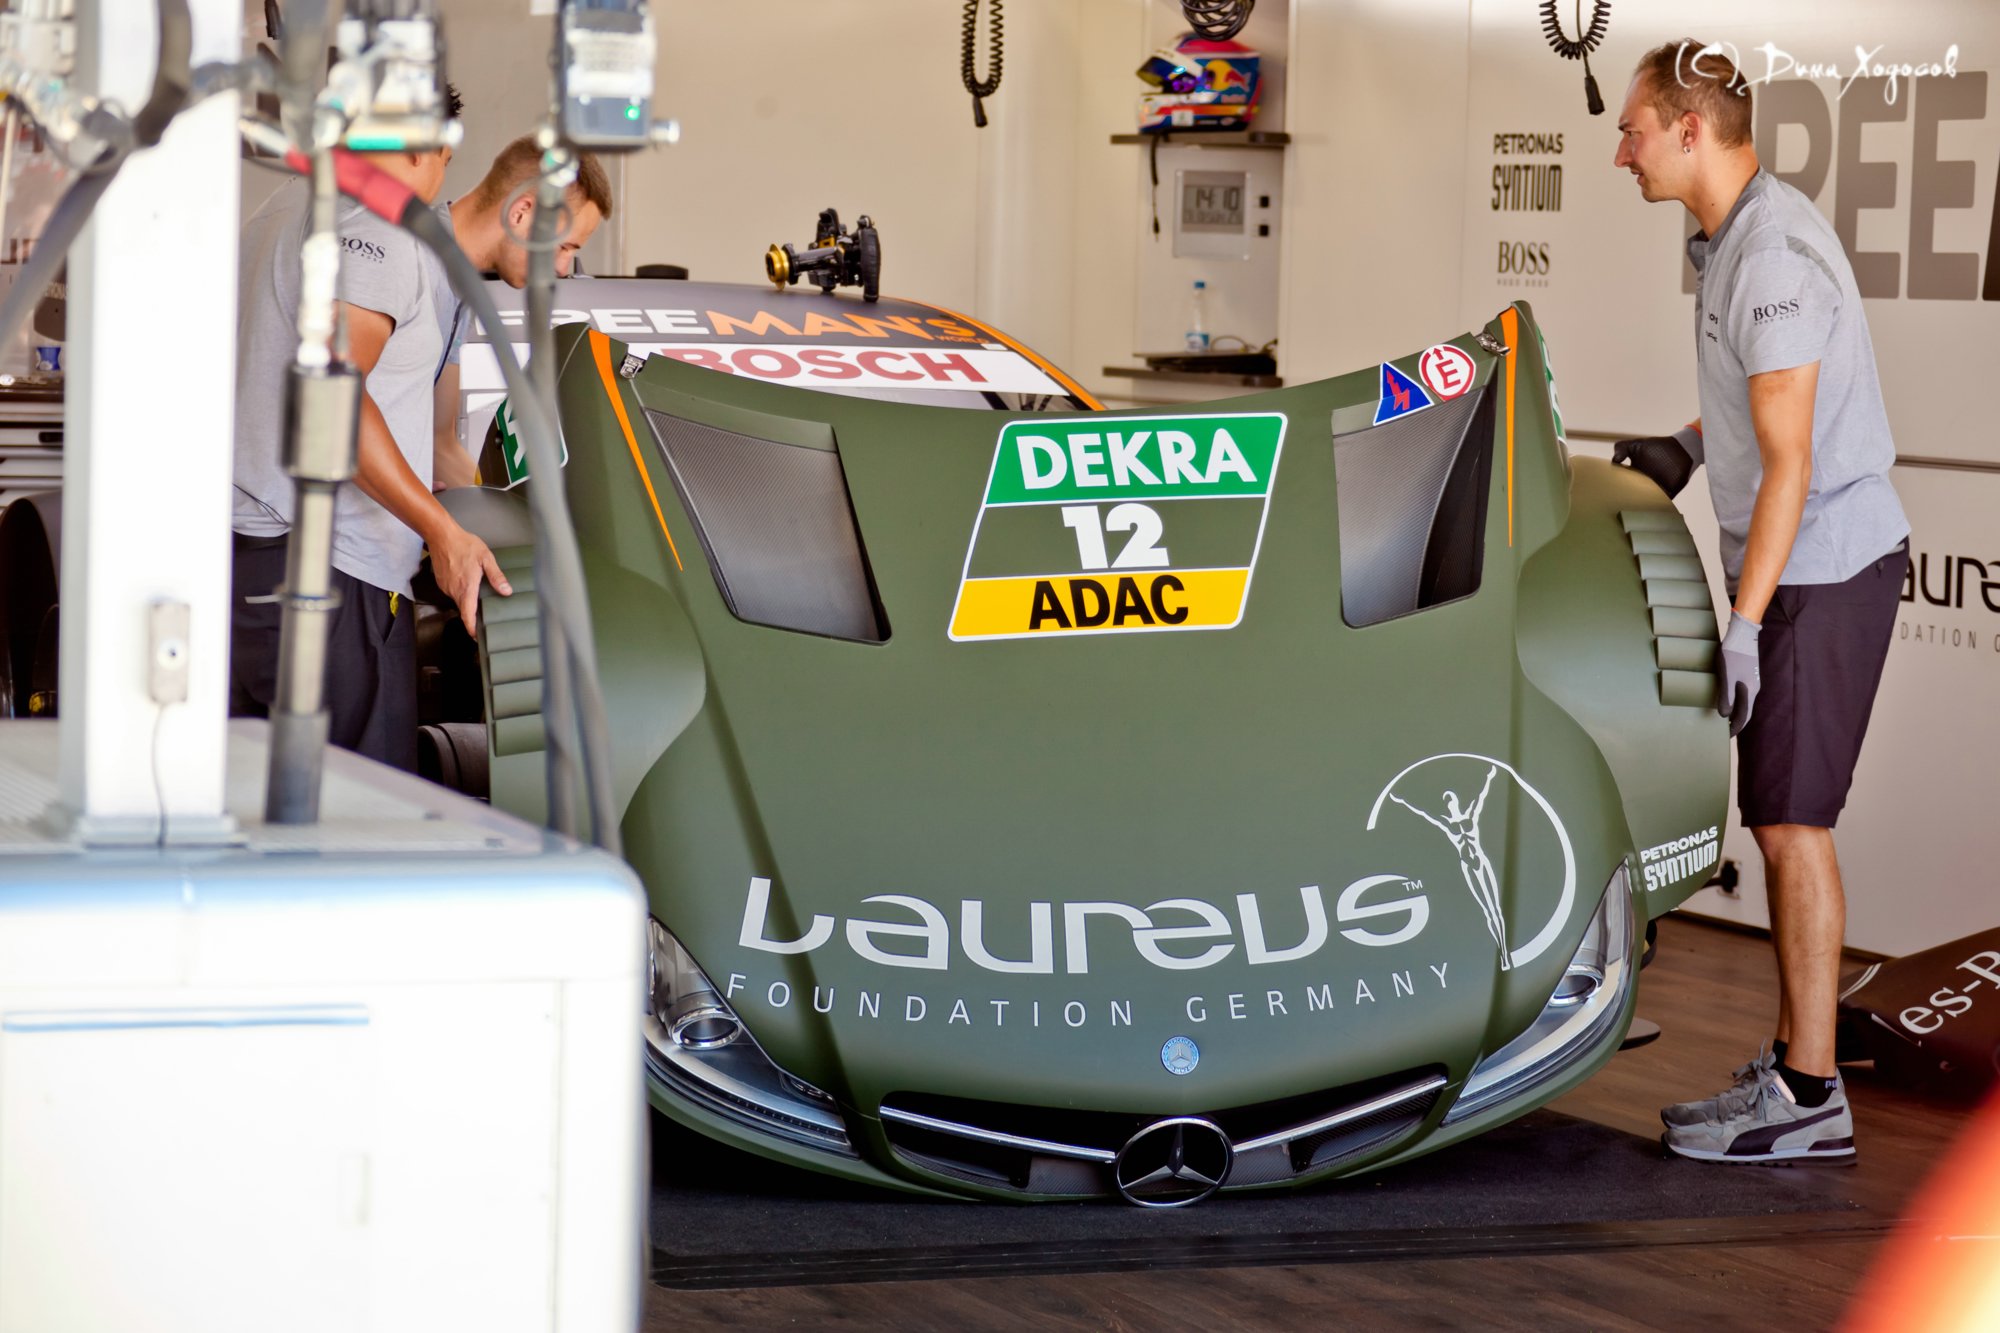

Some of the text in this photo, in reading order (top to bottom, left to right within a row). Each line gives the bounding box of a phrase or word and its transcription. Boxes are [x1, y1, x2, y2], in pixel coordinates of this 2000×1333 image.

[1493, 133, 1564, 155] PETRONAS
[1491, 164, 1563, 212] SYNTIUM
[1498, 241, 1551, 275] BOSS
[1753, 299, 1800, 322] BOSS
[1016, 427, 1258, 490] DEKRA
[1061, 503, 1170, 570] 12
[1029, 574, 1189, 631] ADAC
[1640, 826, 1718, 864] PETRONAS
[1644, 840, 1718, 892] SYNTIUM
[726, 962, 1448, 1027] FOUNDATION GERMANY
